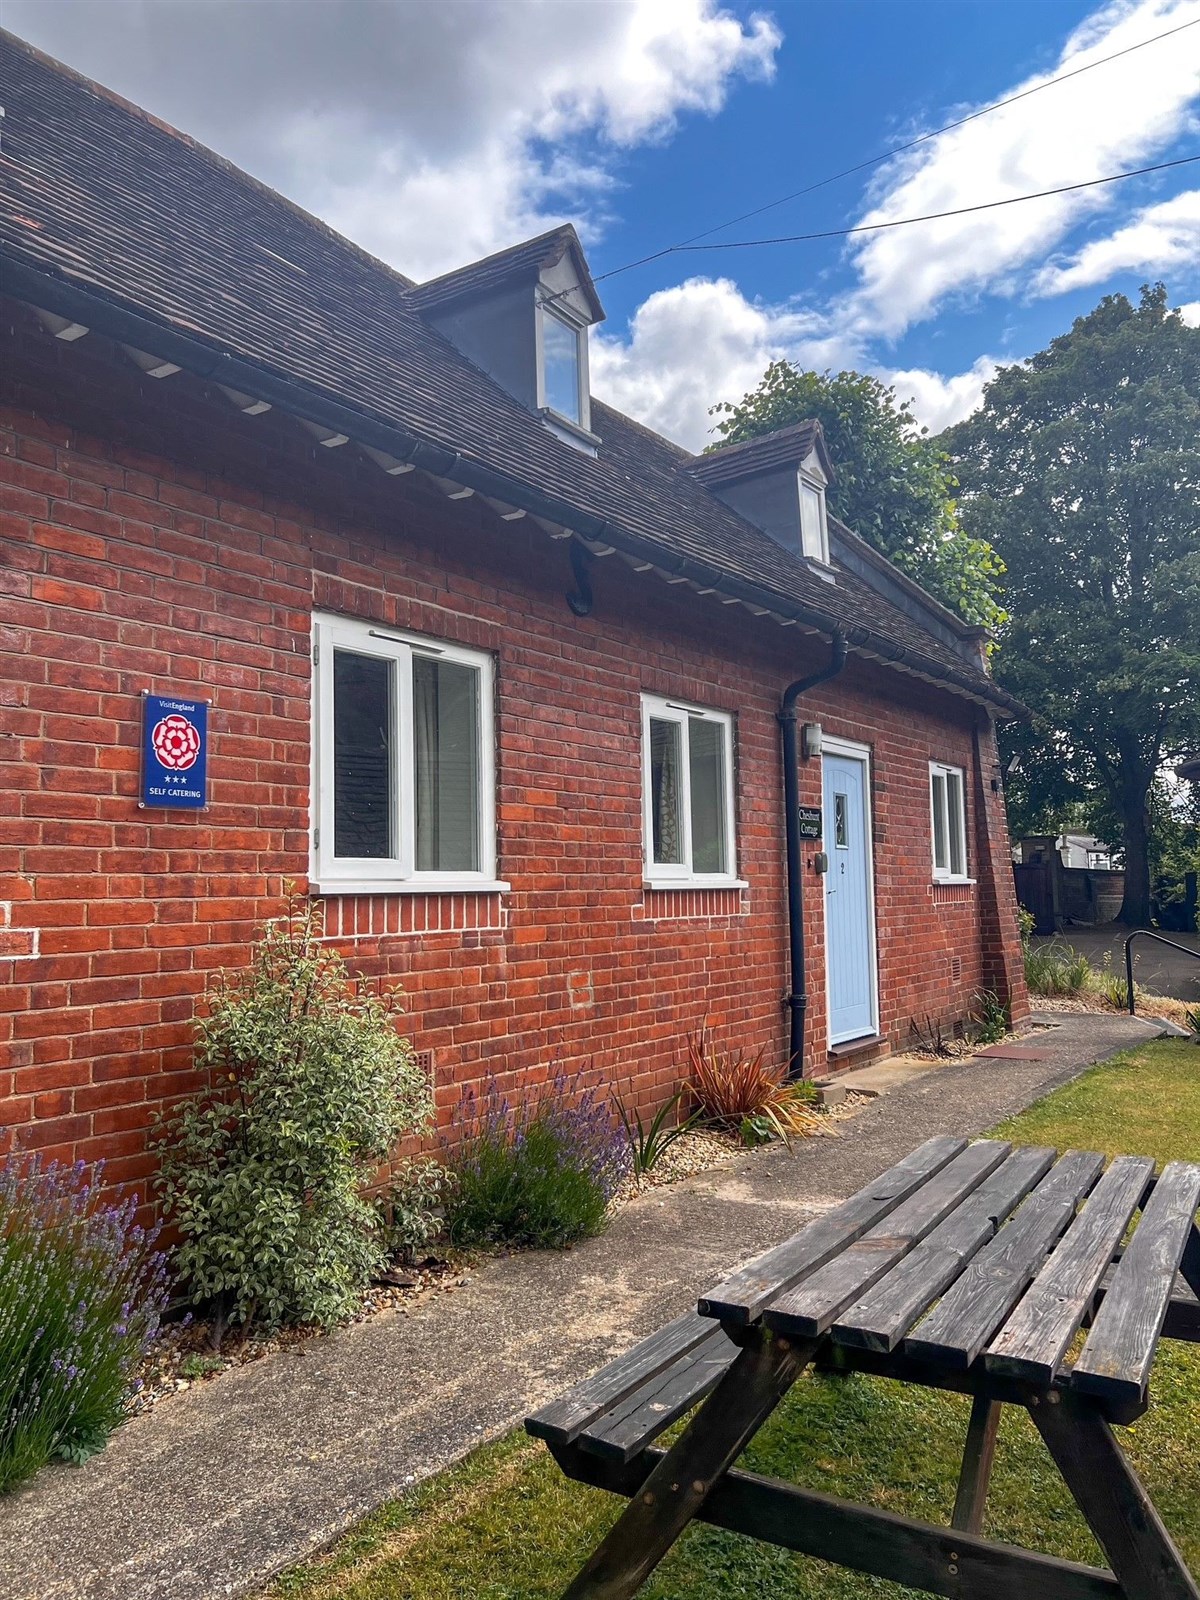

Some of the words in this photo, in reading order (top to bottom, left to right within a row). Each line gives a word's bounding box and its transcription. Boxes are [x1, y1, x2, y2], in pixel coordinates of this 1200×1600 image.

[159, 700, 195, 712] VisitEngland
[149, 787, 166, 796] SELF
[168, 788, 201, 798] CATERING
